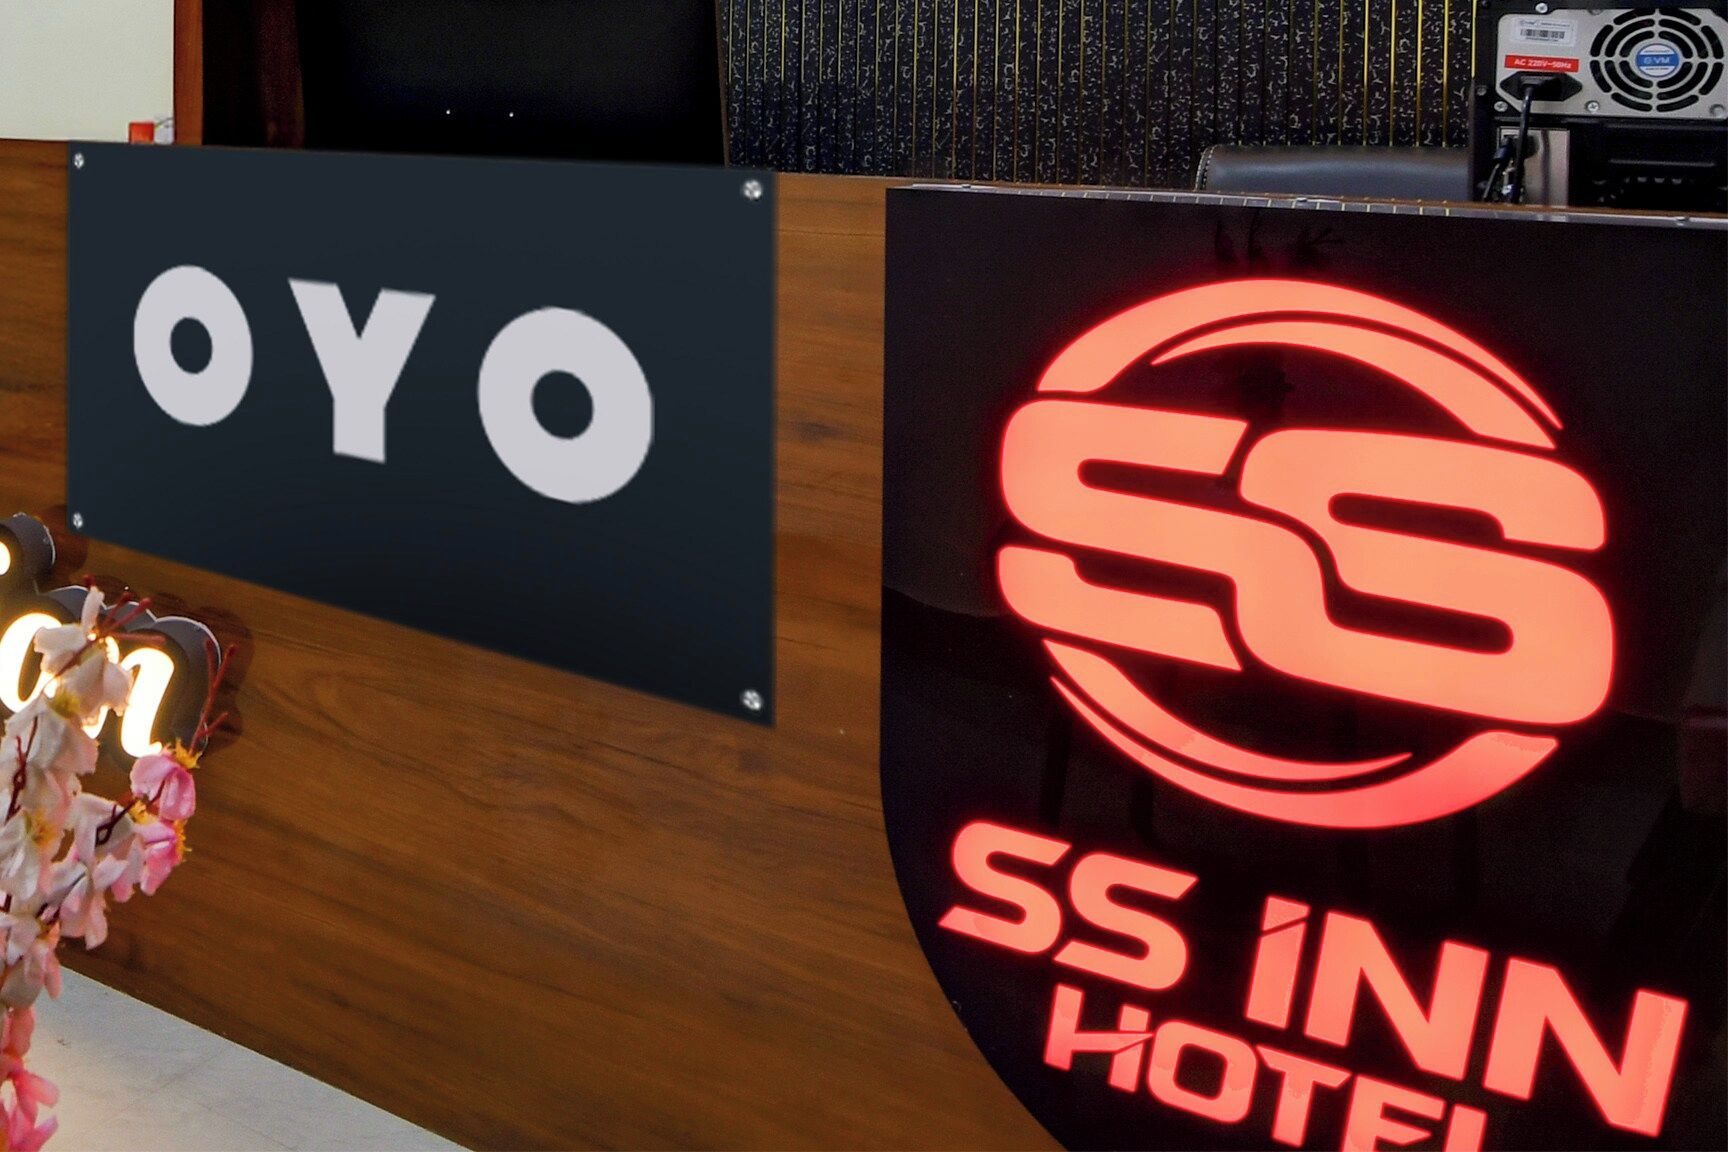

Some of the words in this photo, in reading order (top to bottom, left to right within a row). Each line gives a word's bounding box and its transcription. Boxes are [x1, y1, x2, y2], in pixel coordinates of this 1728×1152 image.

[133, 265, 652, 503] OYO
[997, 398, 1616, 725] SS
[938, 820, 1198, 991] SS
[1245, 896, 1688, 1137] INN
